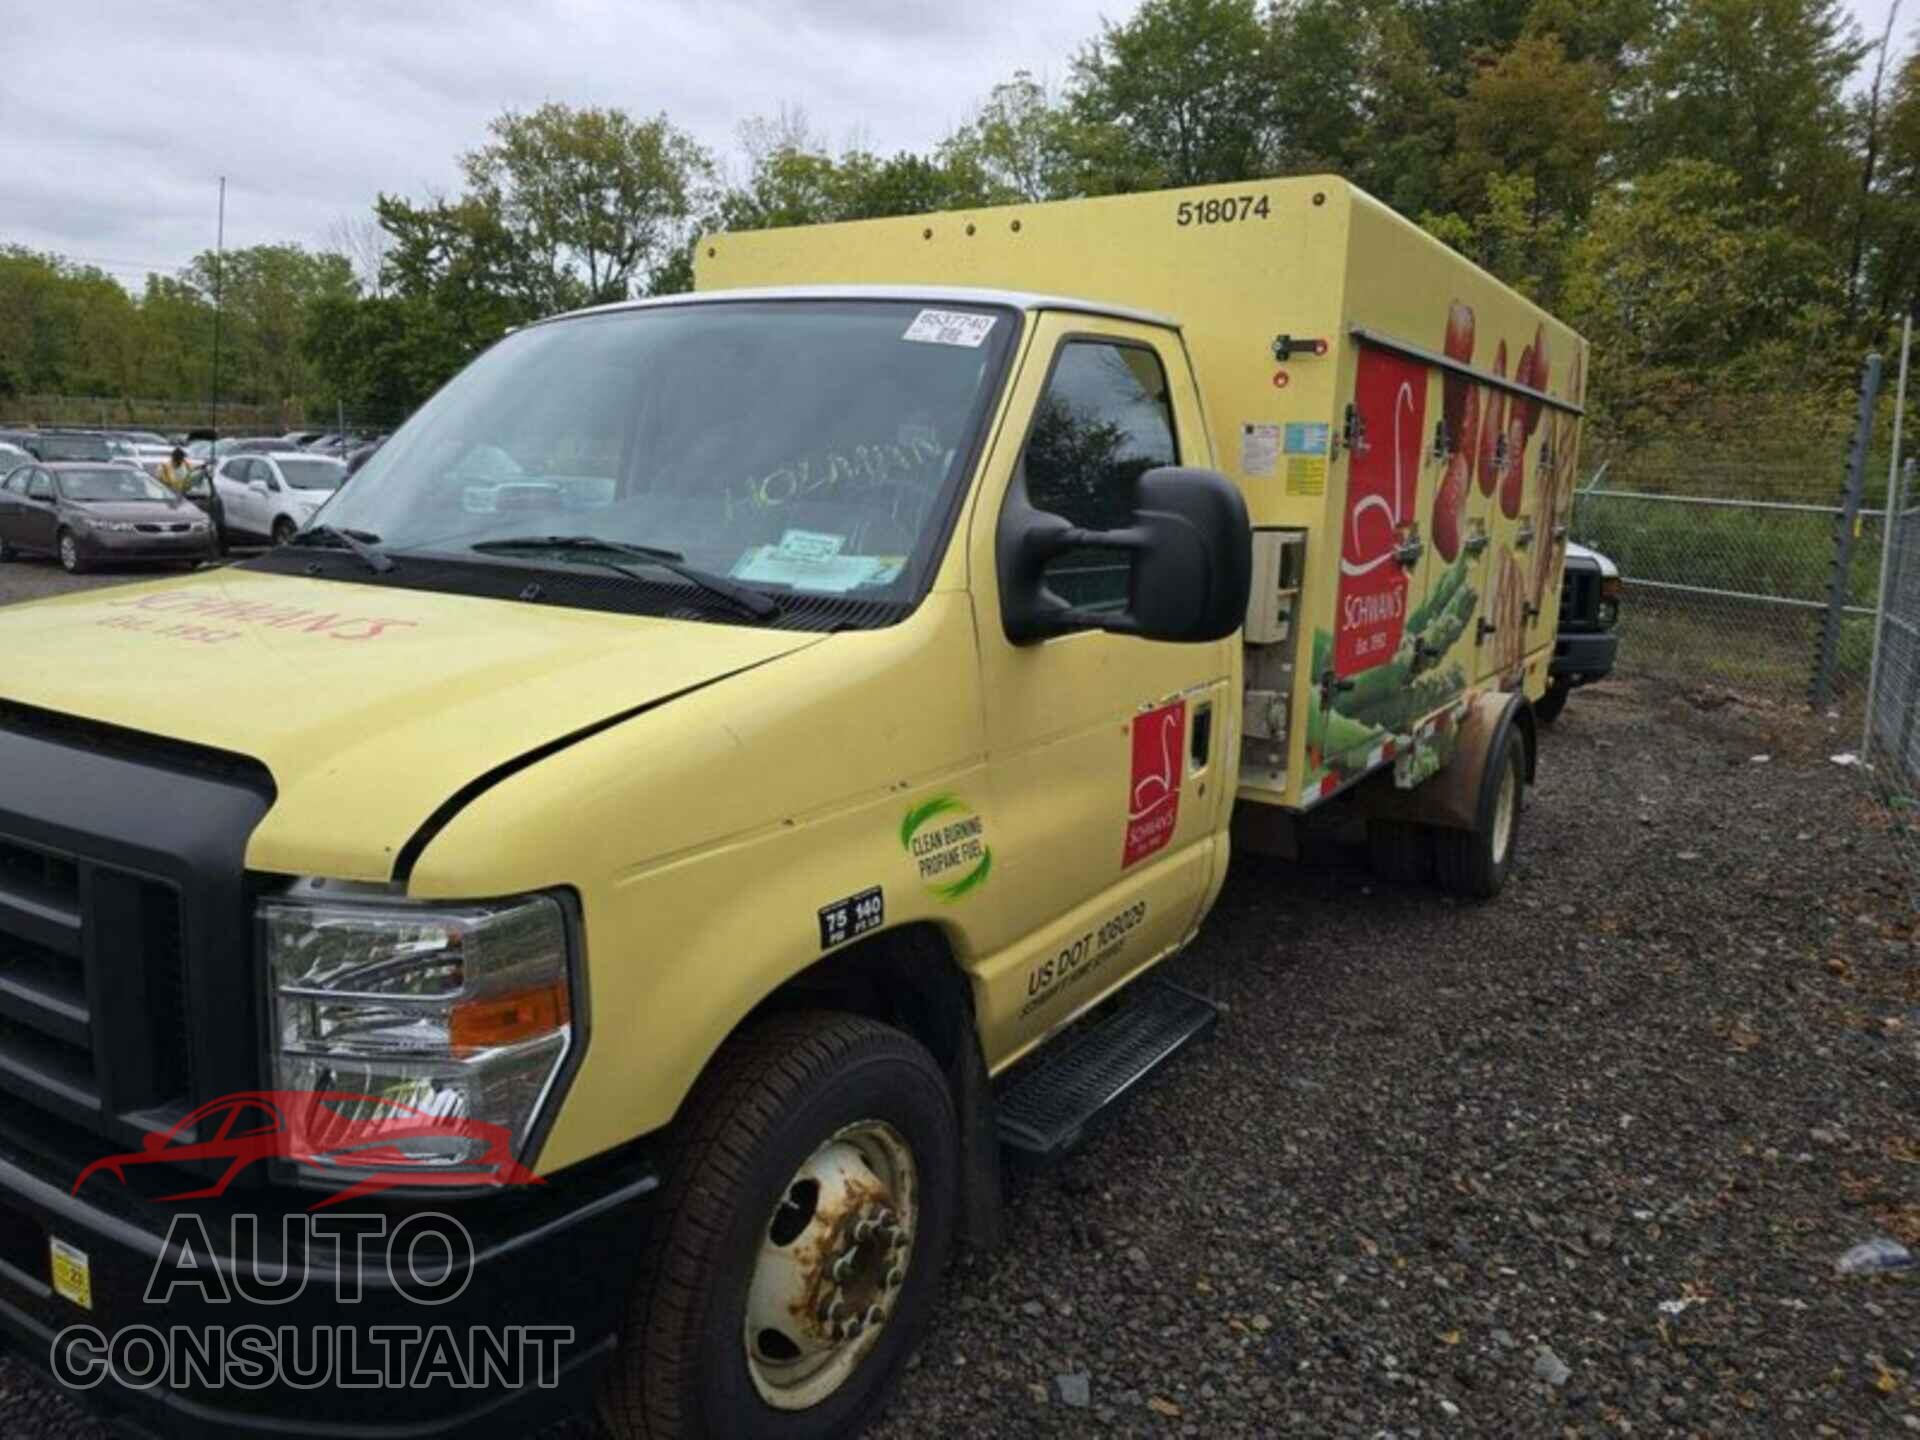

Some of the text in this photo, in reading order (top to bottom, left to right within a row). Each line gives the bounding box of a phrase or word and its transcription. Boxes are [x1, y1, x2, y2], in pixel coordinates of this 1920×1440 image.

[1177, 195, 1271, 226] 518074
[913, 830, 944, 857] CLEAN
[919, 846, 961, 880] PROPANE
[826, 908, 848, 931] 75
[856, 895, 881, 919] 140
[1028, 960, 1054, 995] US
[1057, 933, 1094, 976] DOT
